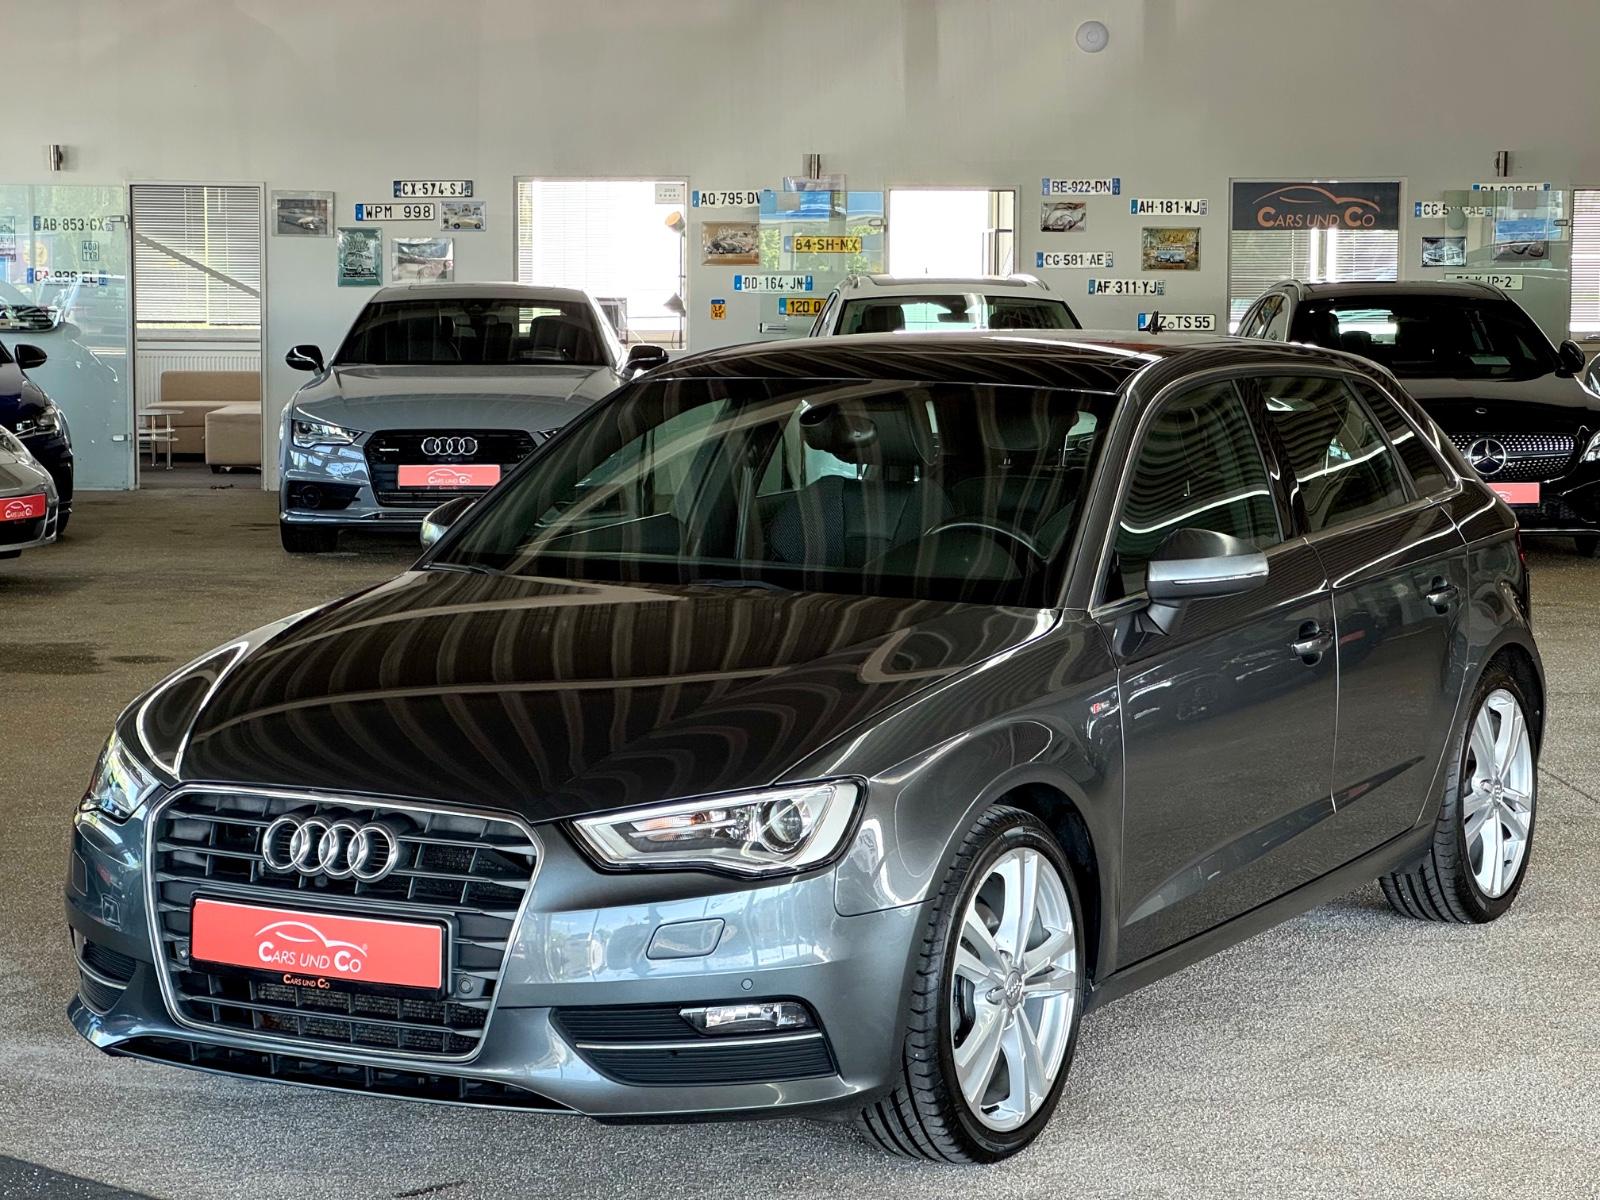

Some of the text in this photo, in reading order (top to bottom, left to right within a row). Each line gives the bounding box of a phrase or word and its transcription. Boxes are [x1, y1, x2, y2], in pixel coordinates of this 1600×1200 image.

[365, 205, 431, 219] WPM 998
[790, 300, 810, 313] 120
[1175, 315, 1192, 329] TS
[1194, 316, 1210, 329] 55
